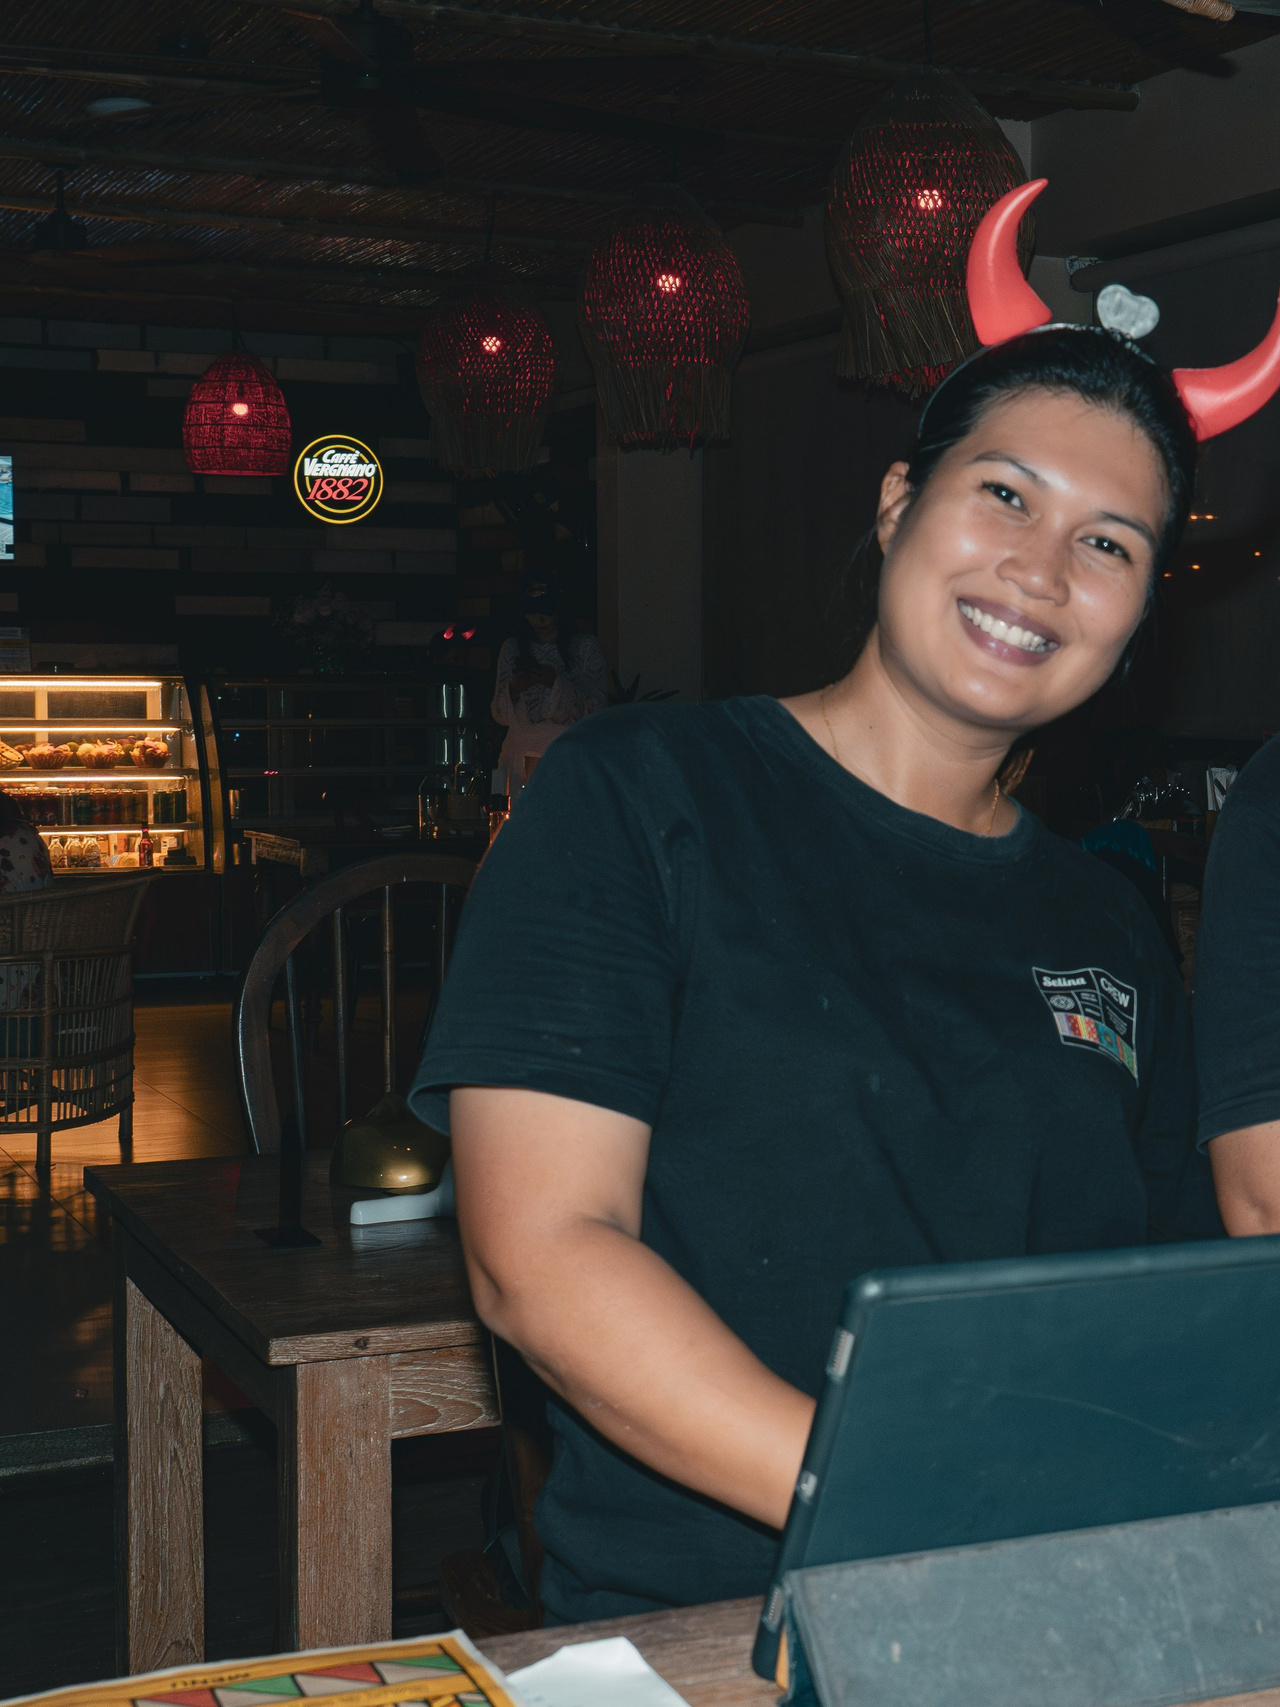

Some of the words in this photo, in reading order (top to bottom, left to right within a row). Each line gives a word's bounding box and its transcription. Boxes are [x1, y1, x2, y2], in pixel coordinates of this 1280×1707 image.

[303, 457, 377, 477] VERGNANO
[305, 478, 369, 500] 1882
[1042, 975, 1087, 987] Selina
